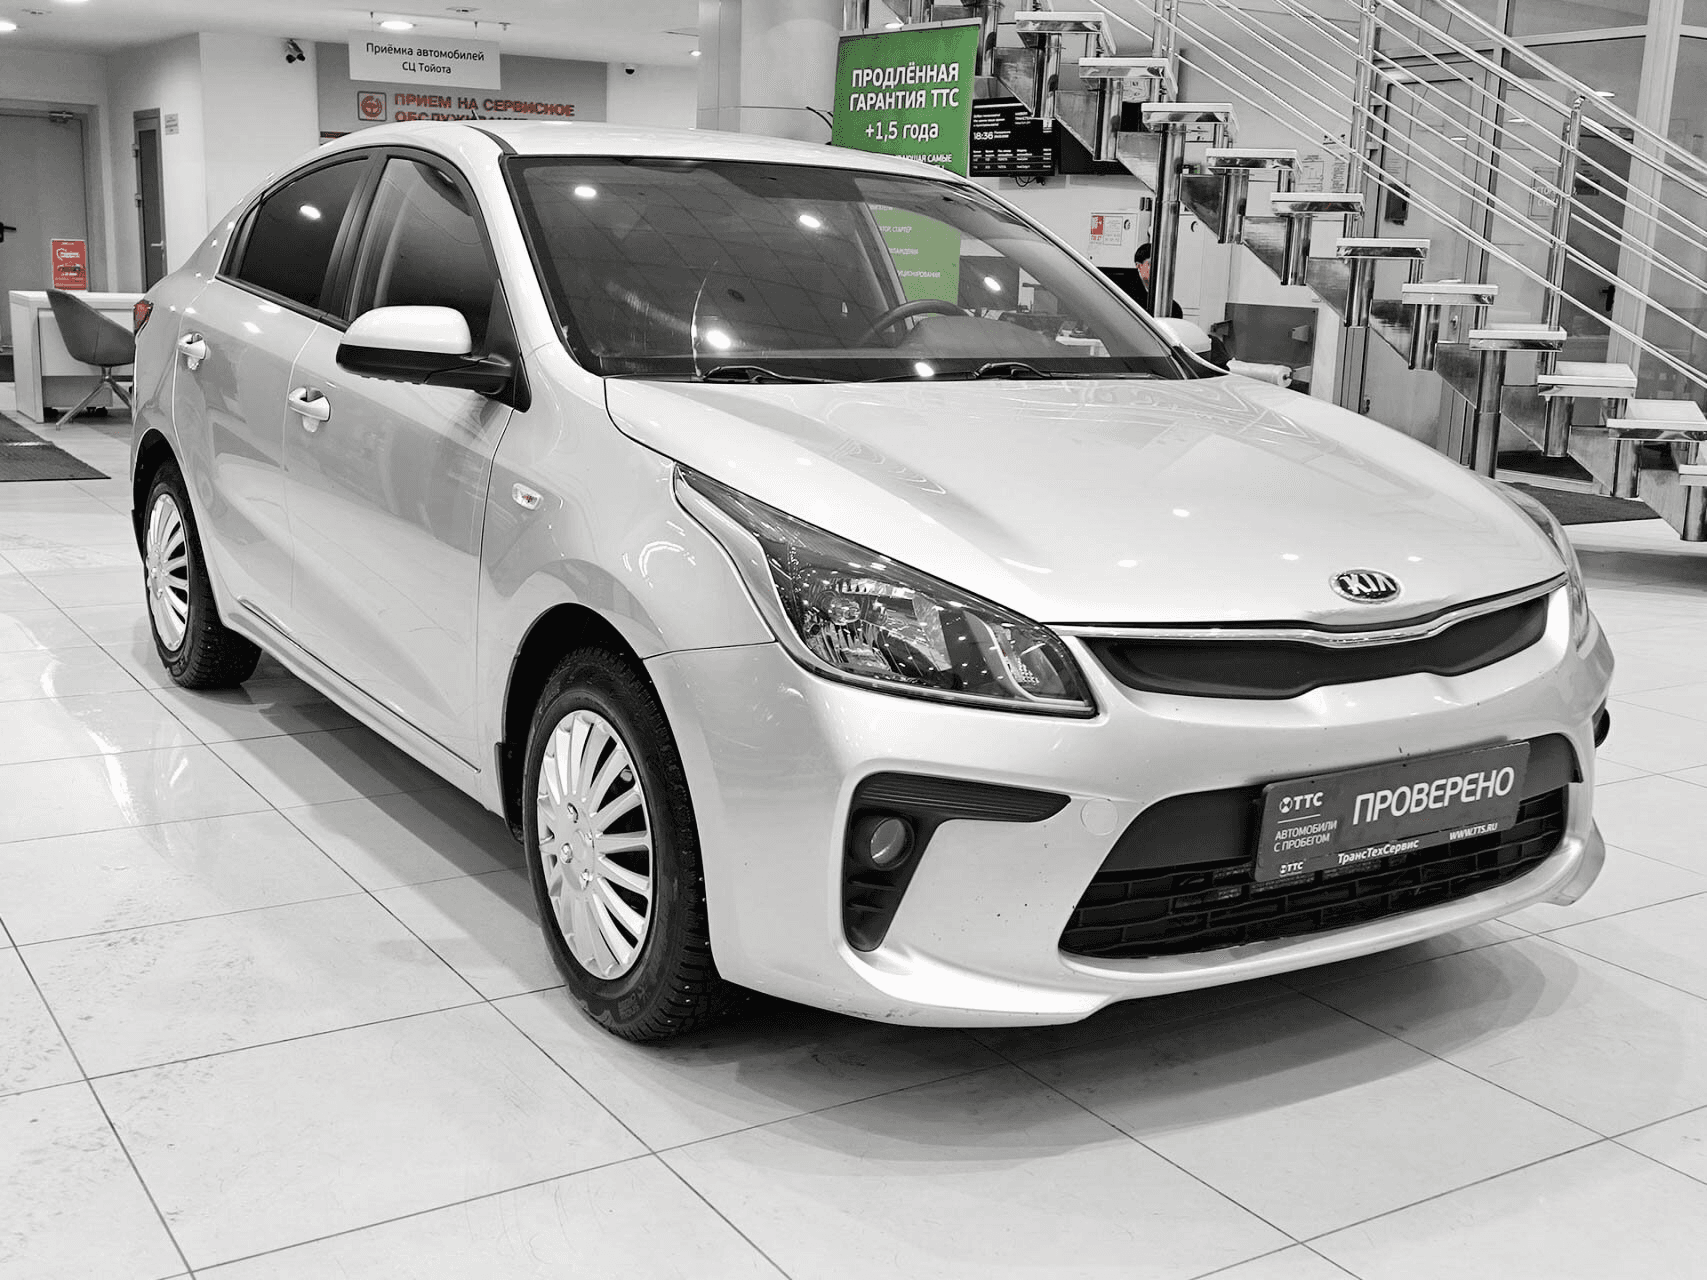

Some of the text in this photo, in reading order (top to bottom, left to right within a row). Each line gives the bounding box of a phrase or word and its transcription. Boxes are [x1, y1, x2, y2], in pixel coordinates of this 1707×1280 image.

[366, 42, 485, 61] Приёмка автомобилей
[402, 61, 452, 74] СЦ Тойота
[852, 61, 960, 90] ПРОДЛЁННАЯ
[394, 93, 575, 117] ПРИЕМ НА СЕРВИСНОЕ
[849, 87, 960, 111] ГАРАНТИЯ ТТС
[865, 121, 940, 142] +1,5 года
[927, 153, 953, 163] САМЫЕ
[1336, 572, 1398, 597] KIA
[1292, 790, 1324, 811] ТТС
[1352, 766, 1515, 825] ПРОВЕРЕНО
[1274, 819, 1338, 841] АВТОМОБИЛИ
[1449, 822, 1499, 841] WWW.TTS.RU
[1273, 832, 1331, 853] С ПРОБЕГОМ
[1337, 839, 1420, 866] ТрансТехСервис
[1287, 861, 1304, 873] ТТС
